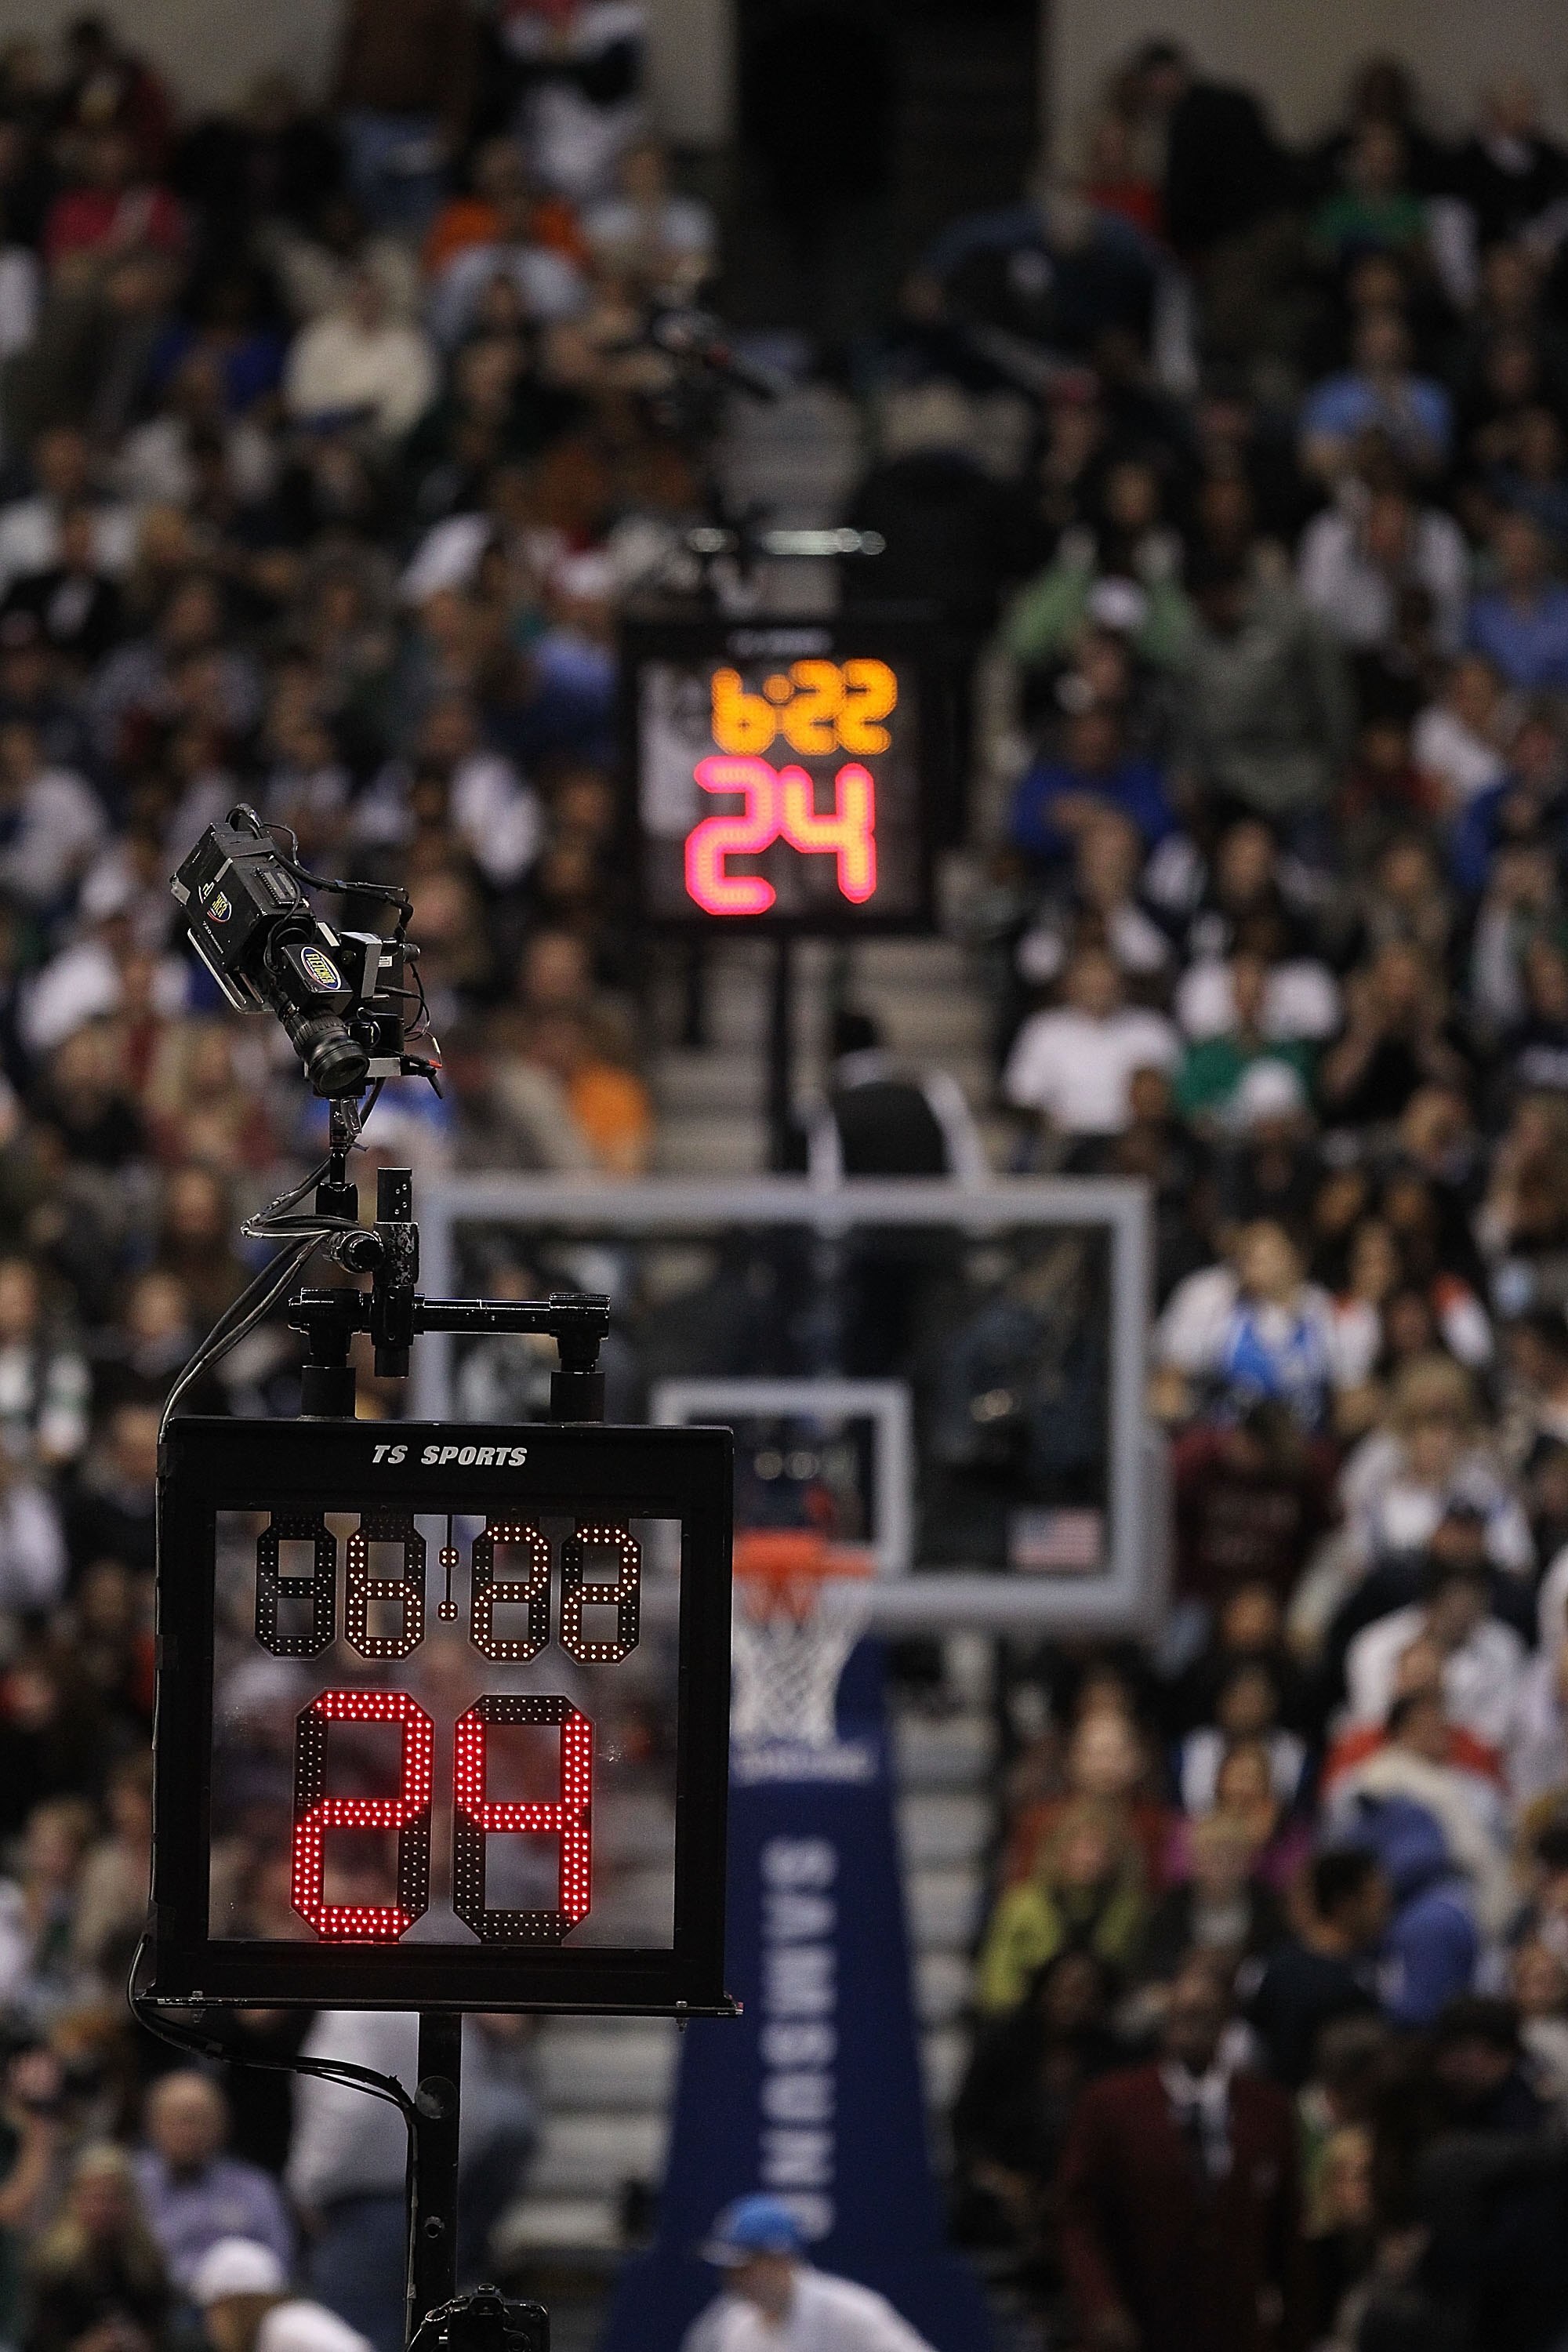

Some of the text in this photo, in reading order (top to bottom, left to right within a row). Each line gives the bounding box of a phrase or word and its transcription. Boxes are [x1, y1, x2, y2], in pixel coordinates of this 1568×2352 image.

[711, 658, 898, 756] 6:22
[684, 756, 877, 916] 24
[305, 953, 336, 984] FLETCHER
[372, 1445, 528, 1466] TS SPORTS
[292, 1688, 593, 1941] 24
